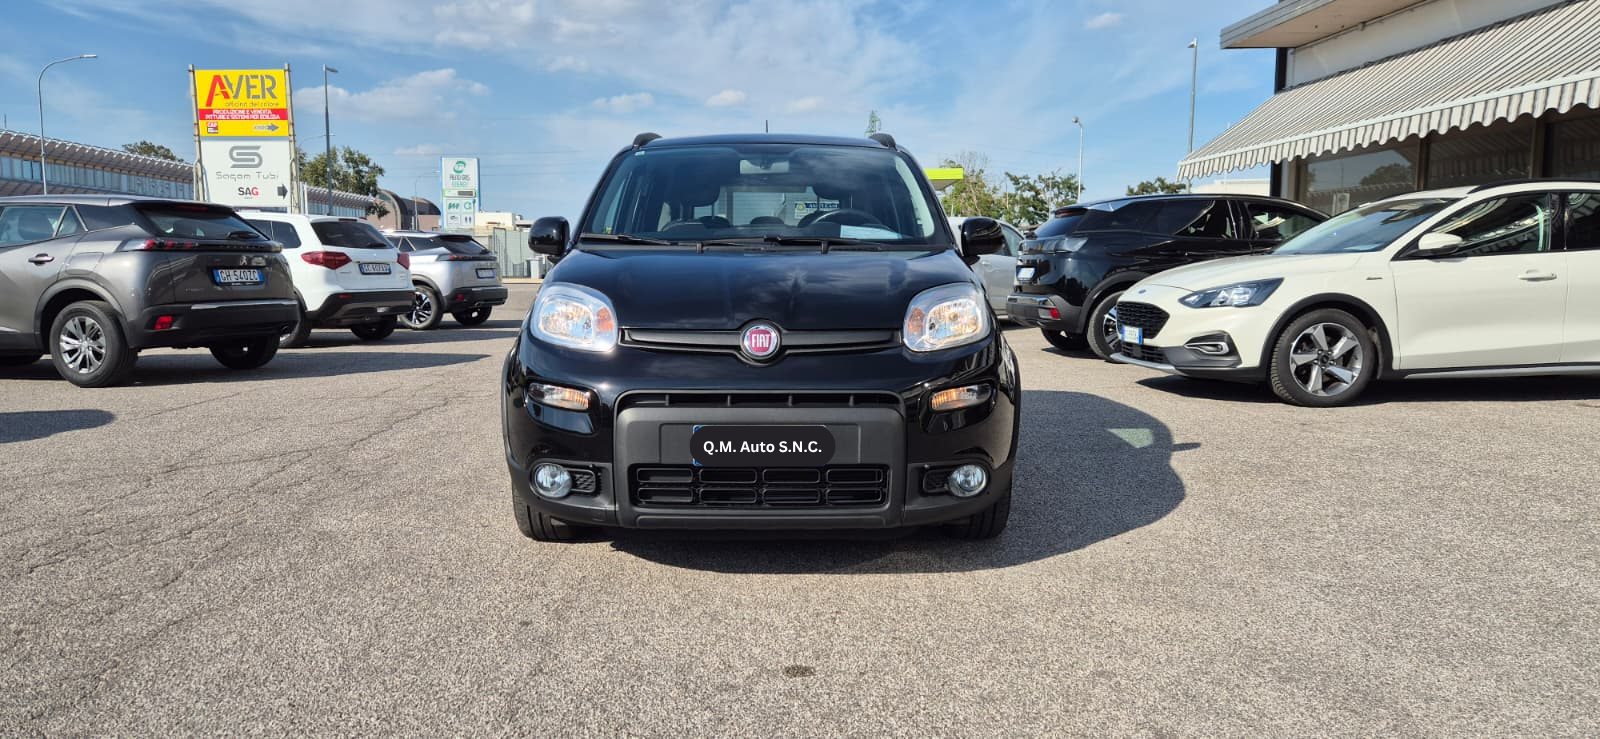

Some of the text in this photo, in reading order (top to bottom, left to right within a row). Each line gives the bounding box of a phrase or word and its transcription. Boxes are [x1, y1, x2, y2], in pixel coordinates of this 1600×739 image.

[206, 74, 278, 108] AVER
[255, 171, 279, 179] Tubi
[238, 187, 259, 196] SAG
[751, 333, 771, 348] FIAT
